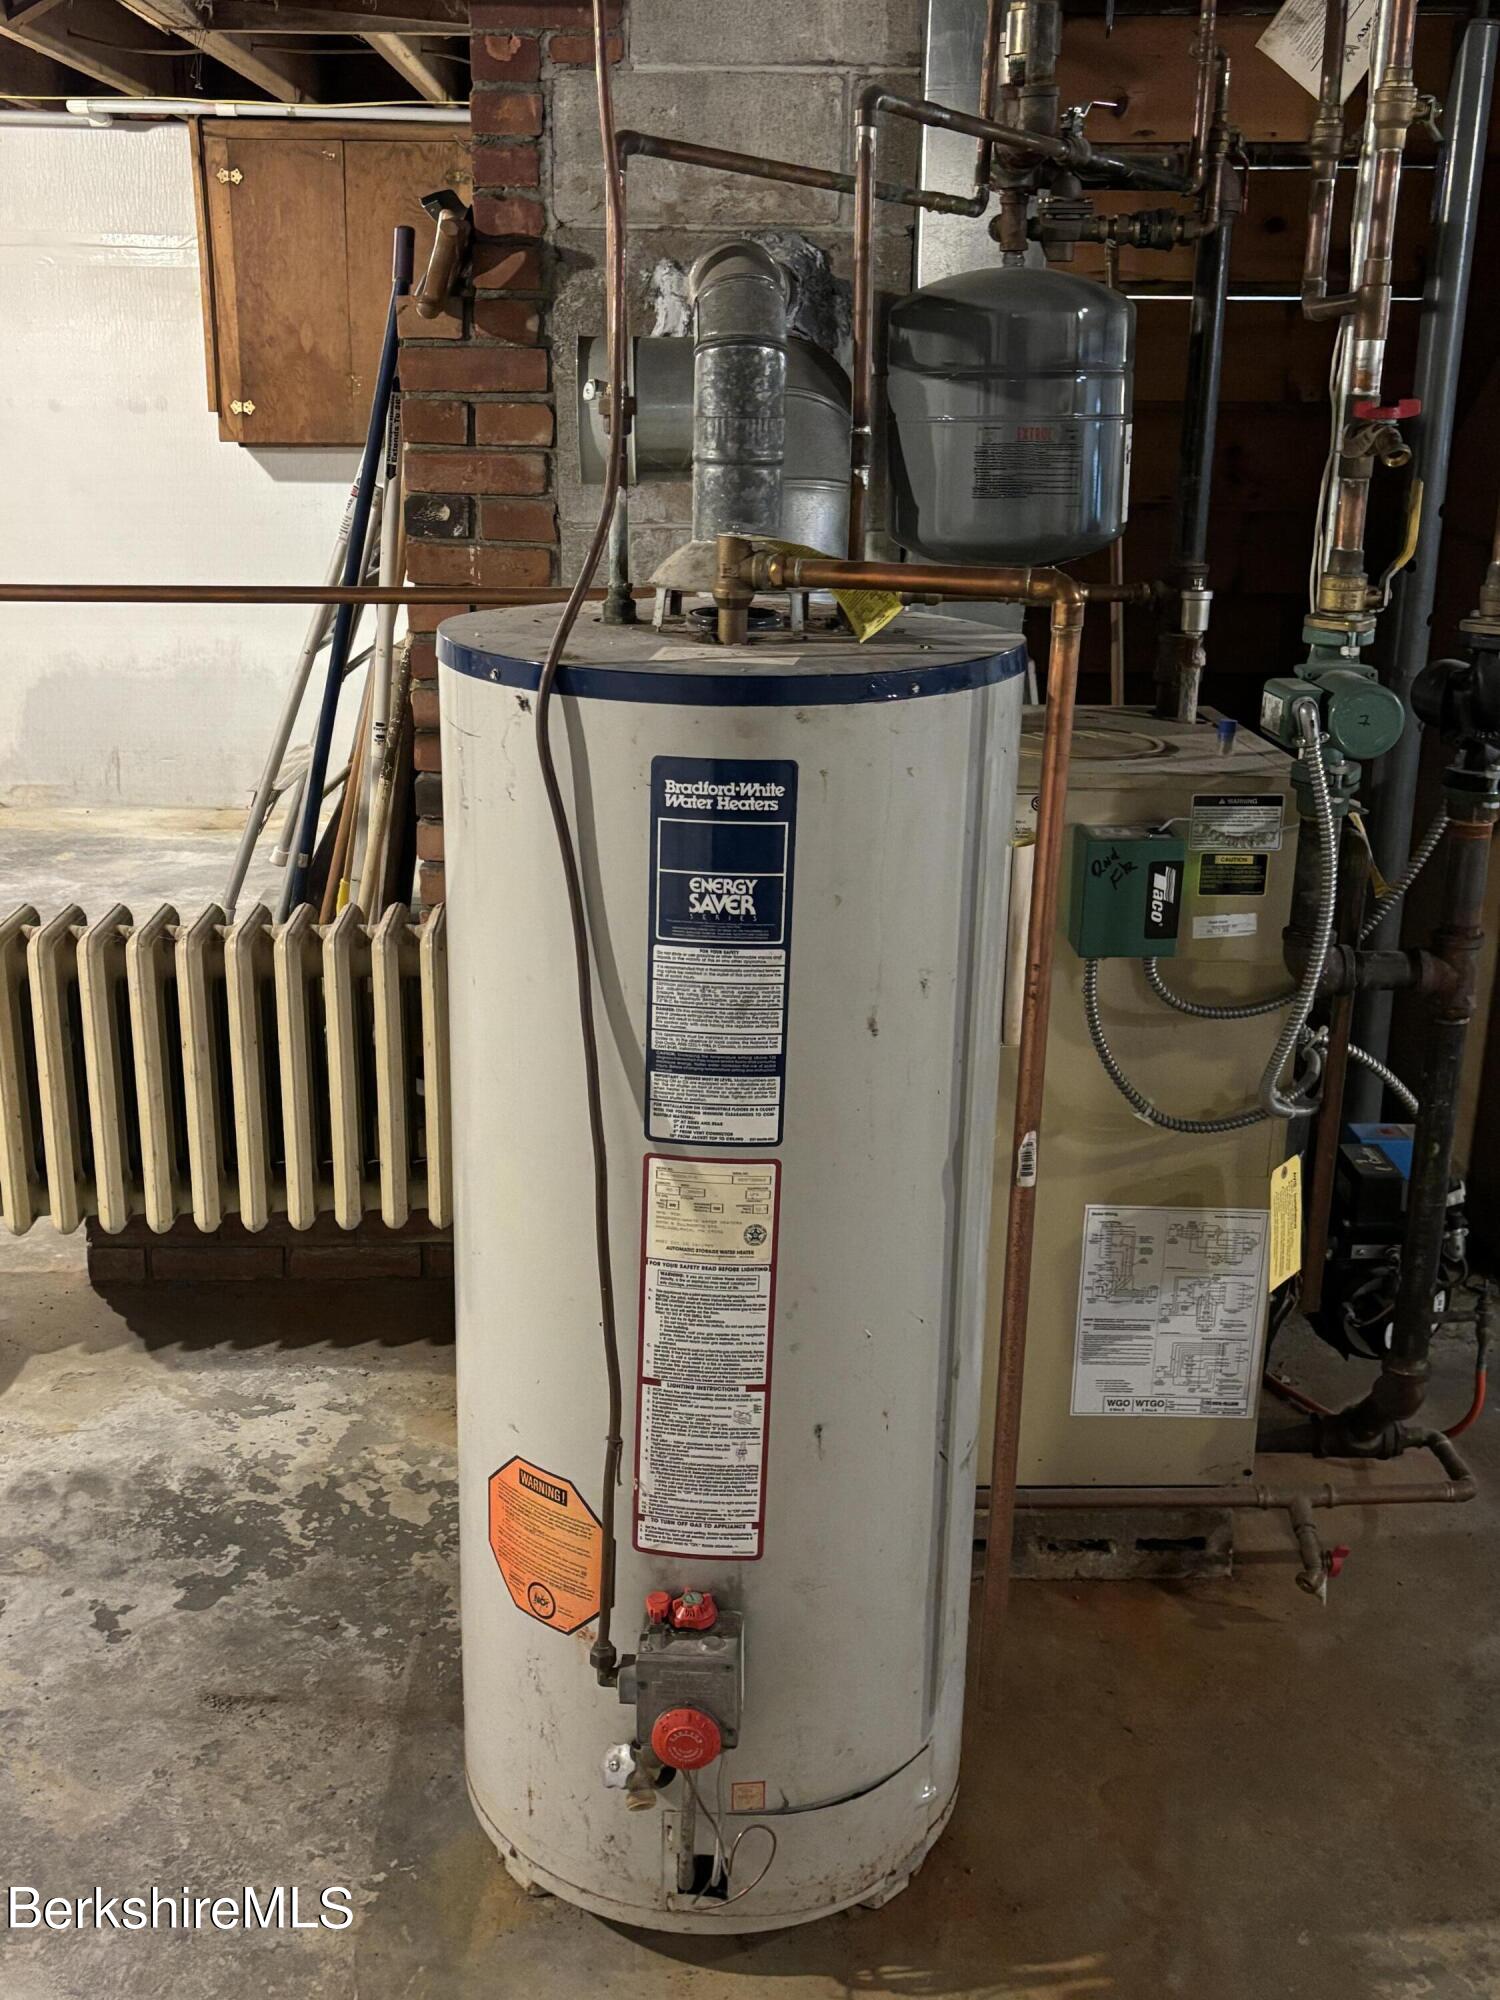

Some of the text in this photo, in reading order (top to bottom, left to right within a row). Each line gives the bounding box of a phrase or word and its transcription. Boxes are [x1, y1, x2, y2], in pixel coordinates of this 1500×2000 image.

[665, 794, 778, 811] Water Heaters
[689, 877, 758, 895] ENERGY
[1151, 866, 1177, 924] Taco
[689, 894, 757, 916] SAVER
[1107, 1399, 1165, 1408] WGO WTGO
